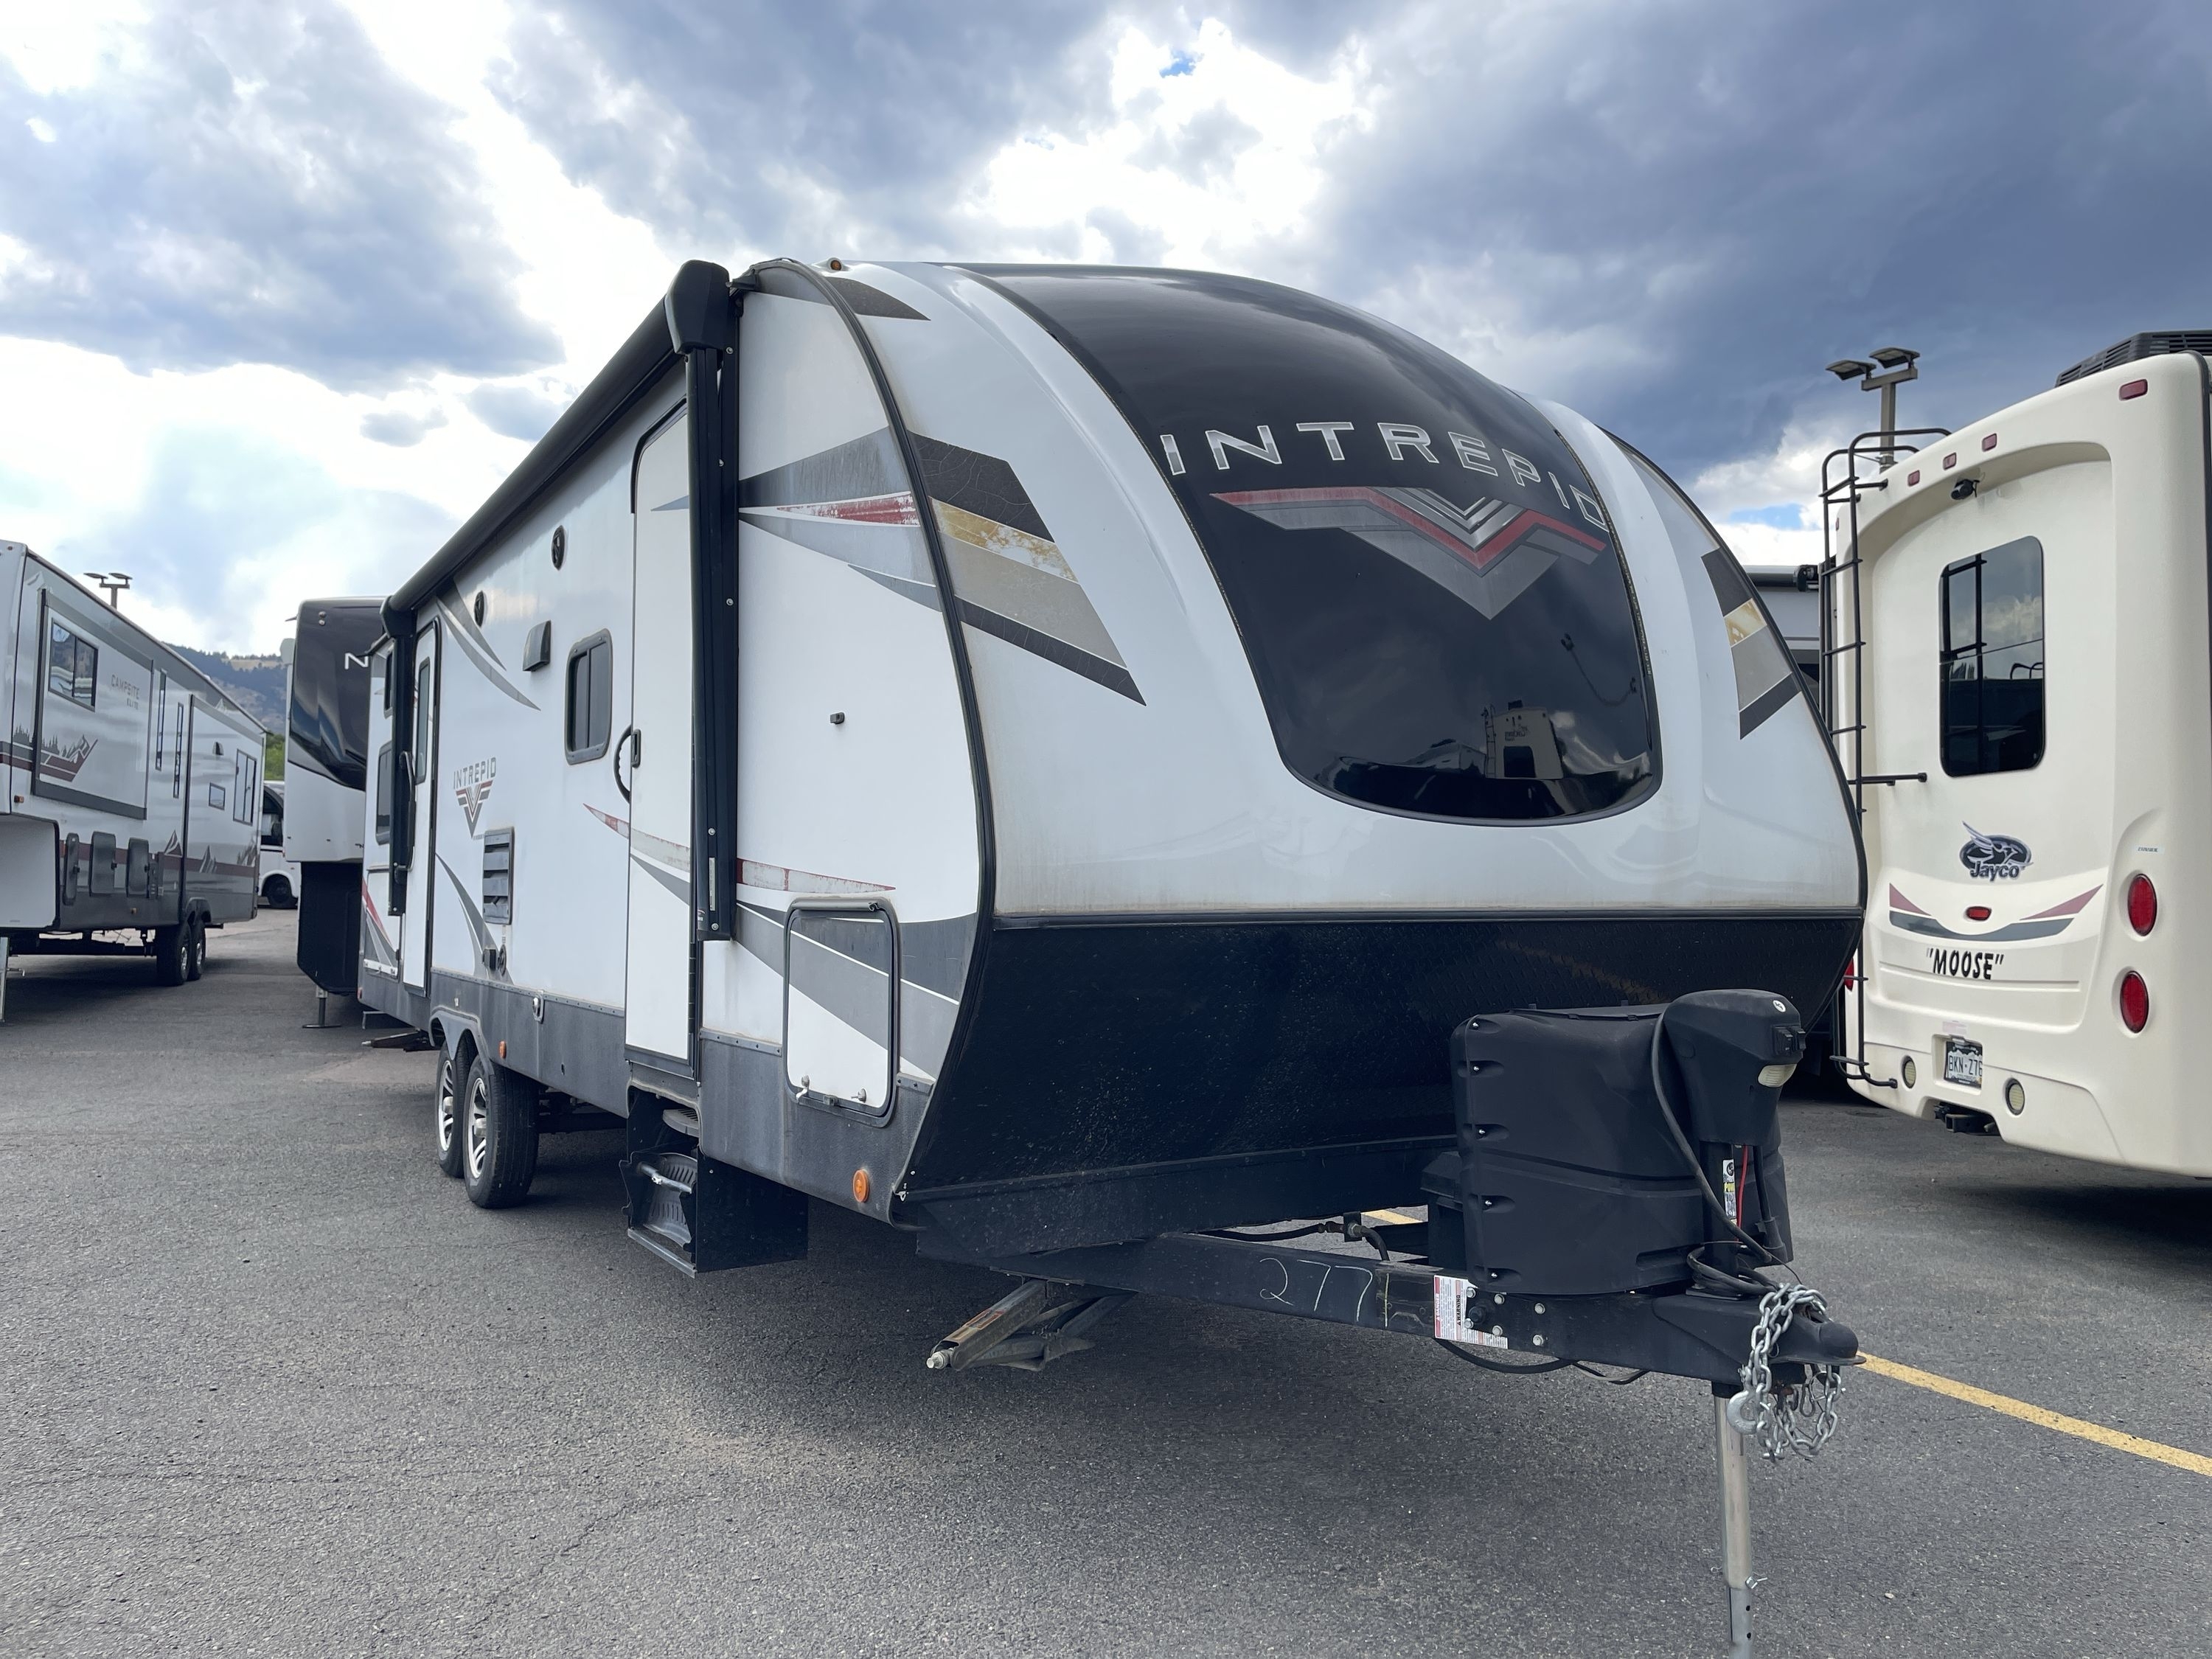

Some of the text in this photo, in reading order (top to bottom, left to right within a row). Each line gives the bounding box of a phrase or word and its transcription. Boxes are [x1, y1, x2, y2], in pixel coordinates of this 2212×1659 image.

[1160, 421, 1610, 532] INTREPID
[111, 674, 139, 700] CAMPSITE
[453, 757, 496, 789] INTREPID
[1970, 861, 2020, 881] Jayco
